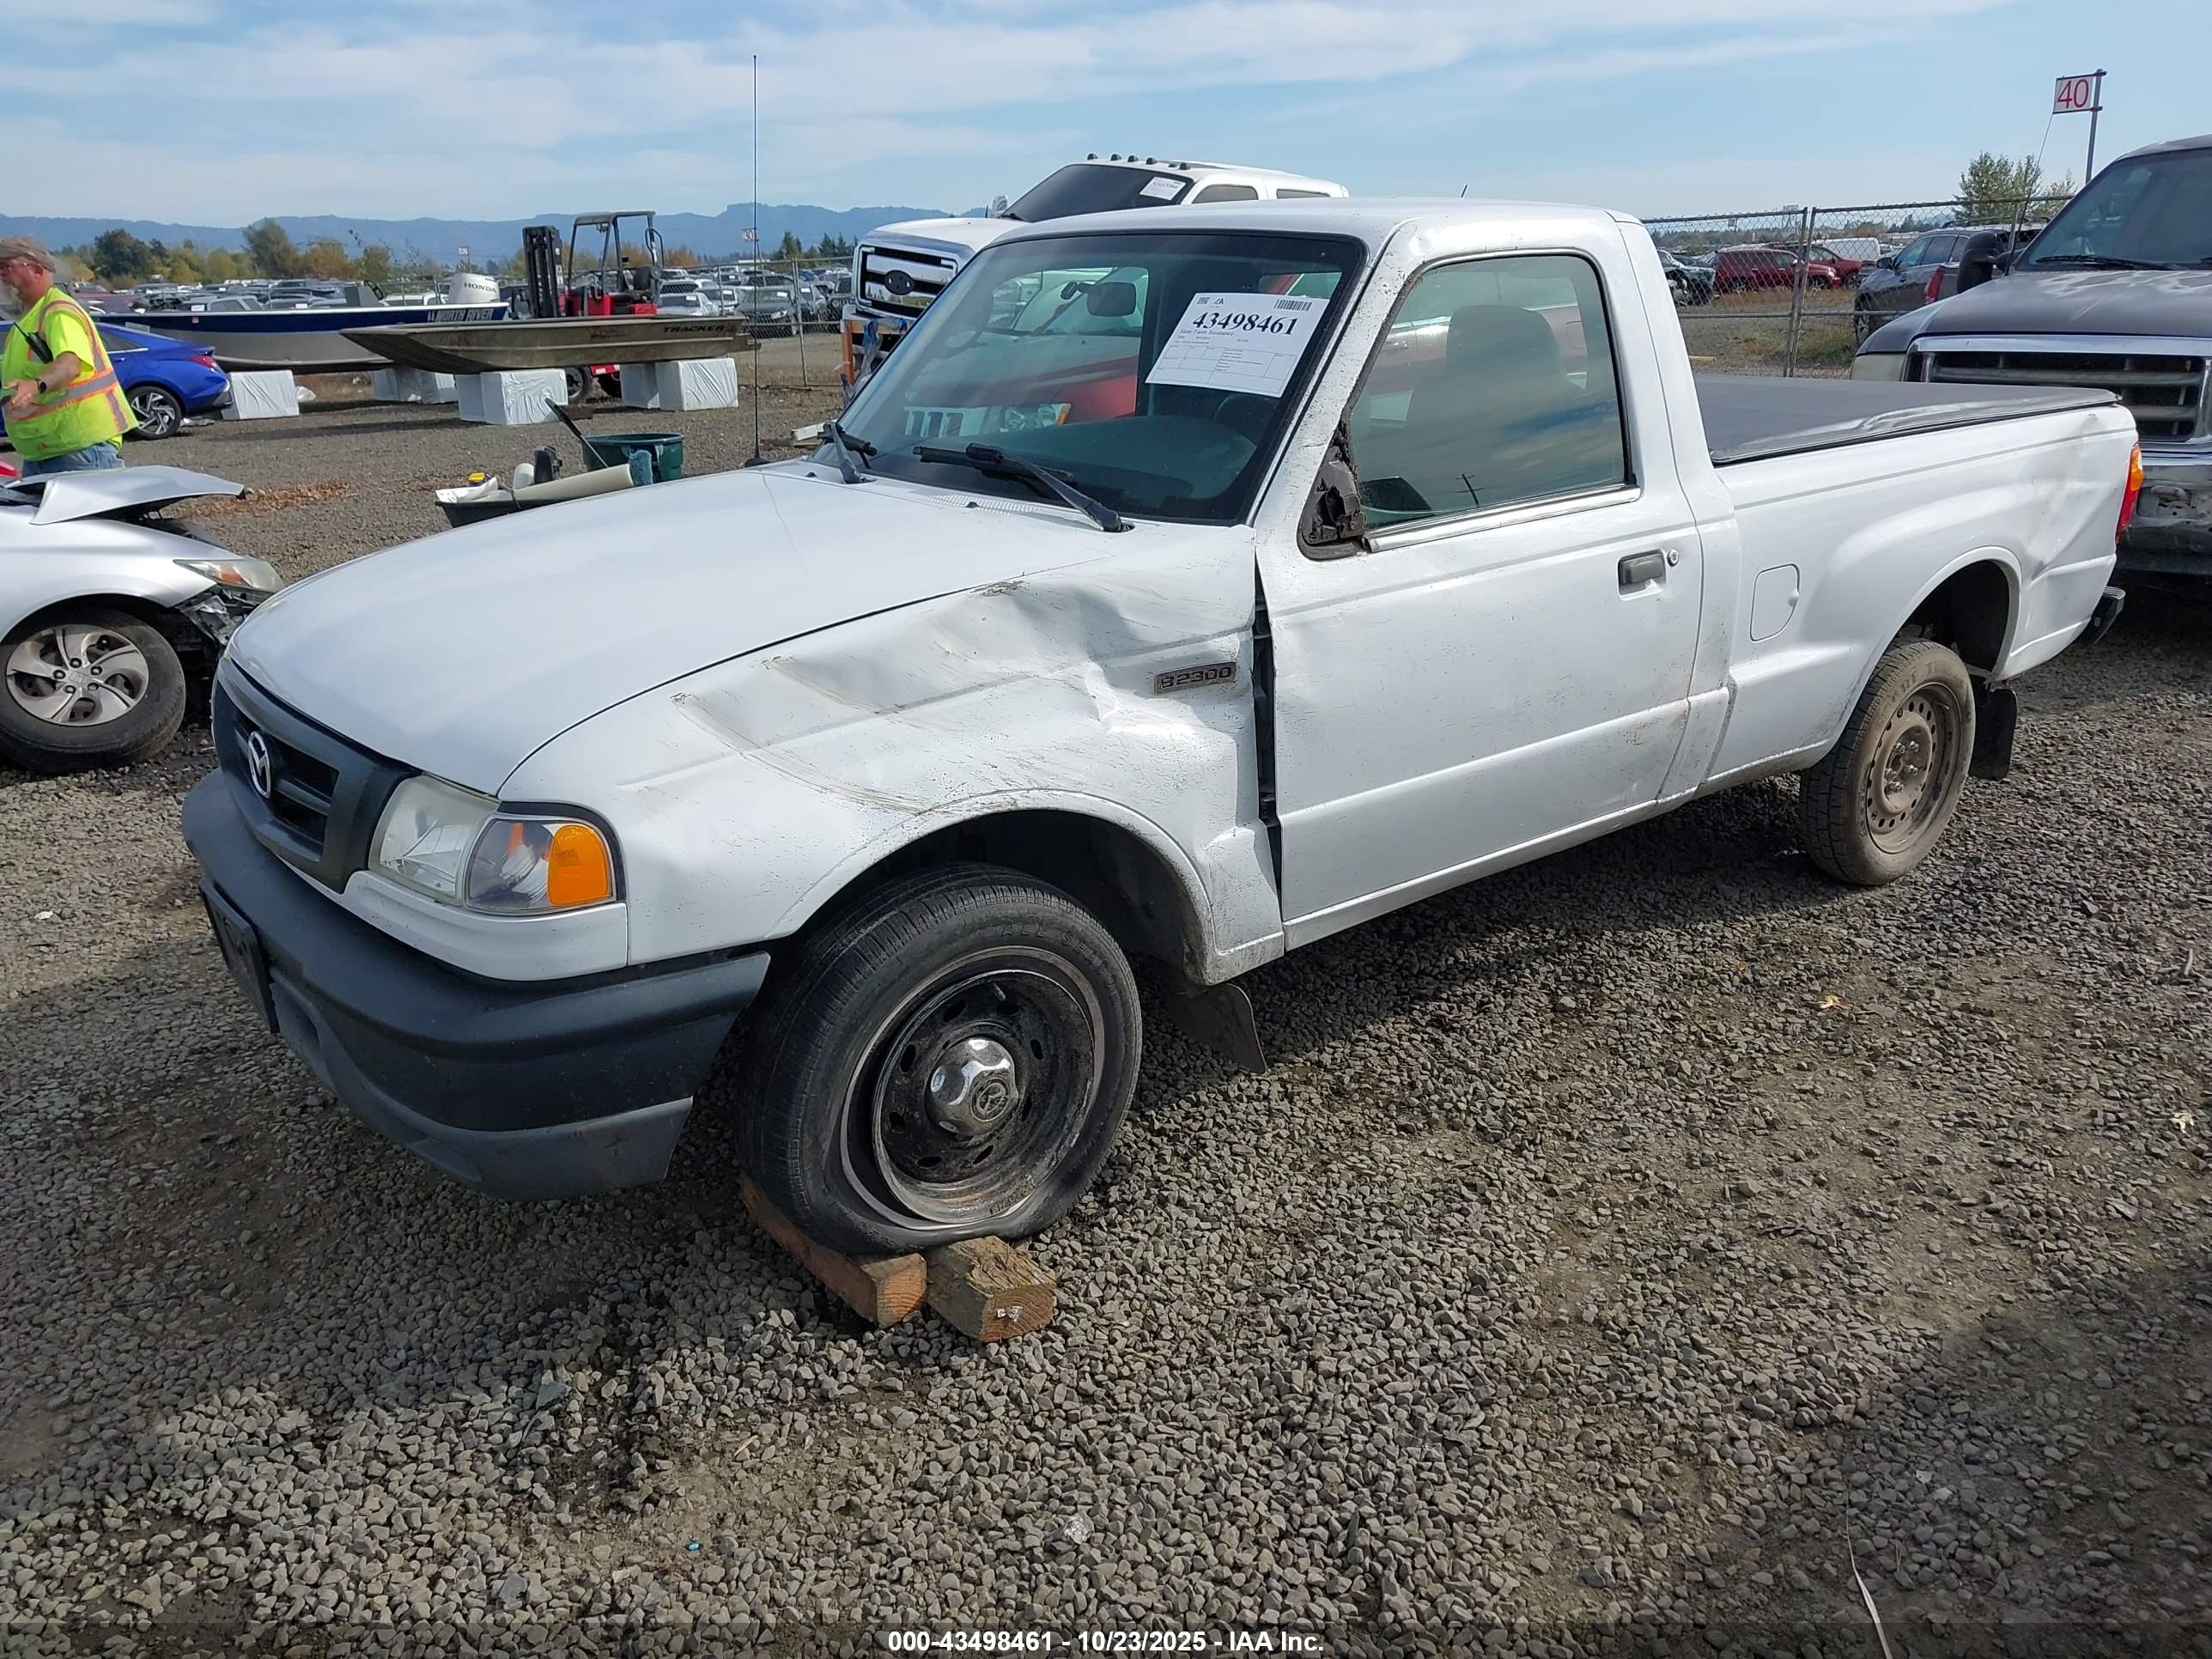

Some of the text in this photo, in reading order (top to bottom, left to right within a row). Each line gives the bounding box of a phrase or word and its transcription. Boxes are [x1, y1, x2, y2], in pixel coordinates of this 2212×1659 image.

[2057, 79, 2089, 108] 40
[465, 283, 496, 293] HONDA
[435, 308, 495, 323] NORTH RIVER
[1192, 312, 1298, 335] 43498461
[1002, 918, 1046, 938] ALL
